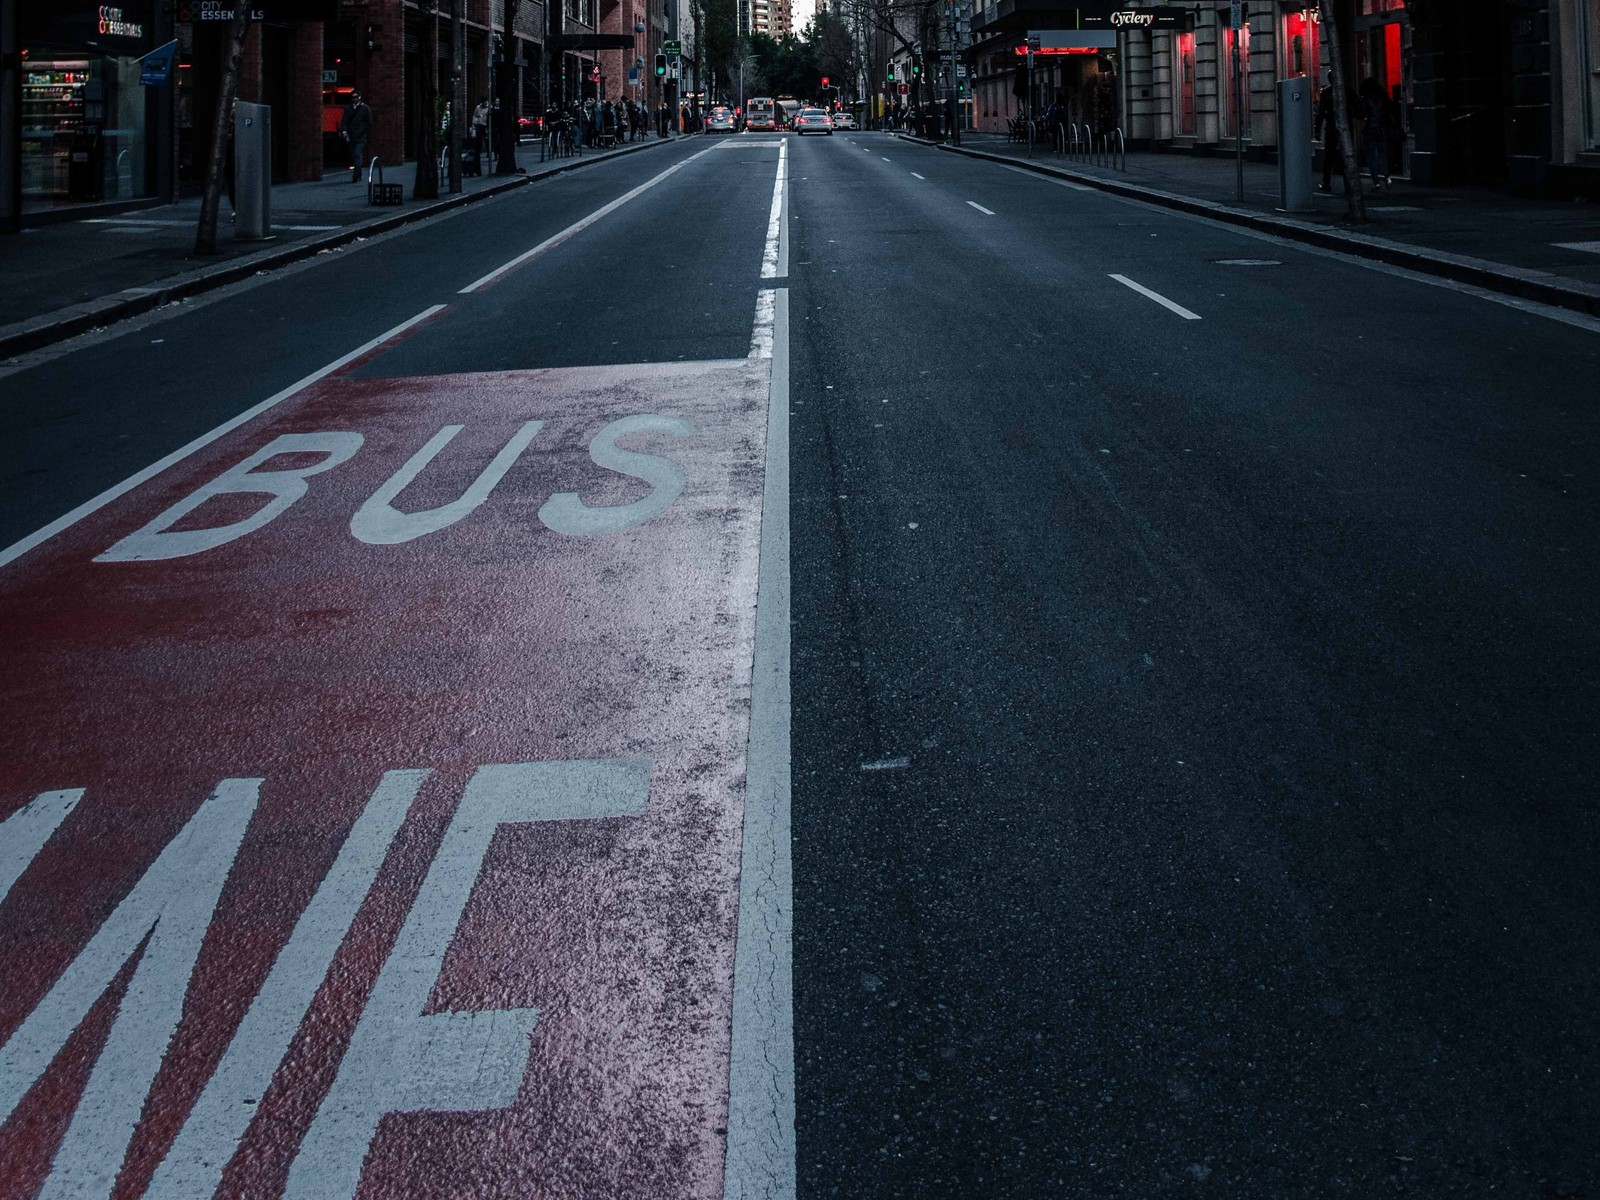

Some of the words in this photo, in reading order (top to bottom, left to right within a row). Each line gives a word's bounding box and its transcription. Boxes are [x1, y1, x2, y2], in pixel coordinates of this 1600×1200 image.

[201, 0, 223, 10] CITY
[201, 10, 265, 21] ESSENLS
[1110, 10, 1154, 27] Cyclery
[91, 412, 695, 563] BUS
[0, 757, 655, 1200] NE
